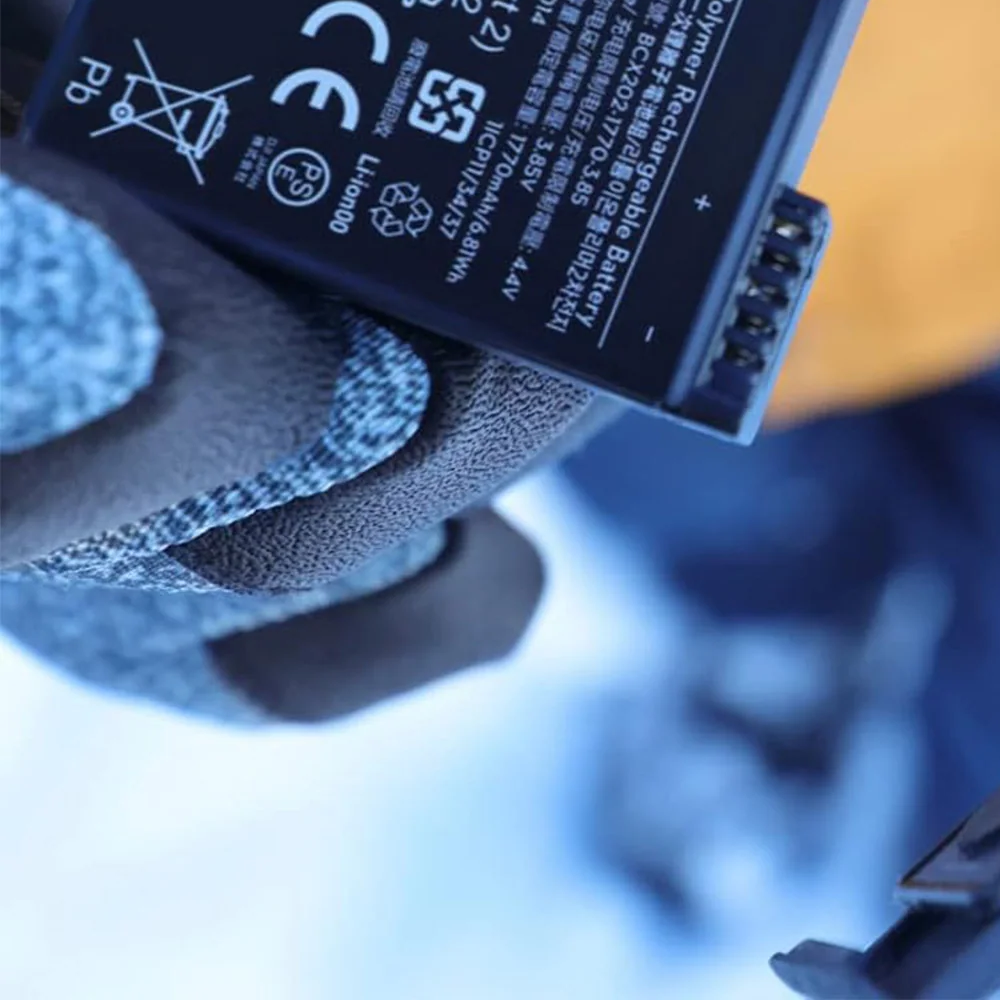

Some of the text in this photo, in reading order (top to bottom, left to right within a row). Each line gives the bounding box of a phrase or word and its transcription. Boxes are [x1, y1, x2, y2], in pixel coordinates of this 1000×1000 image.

[469, 17, 512, 53] 2)
[64, 56, 113, 105] Pb
[570, 31, 657, 207] BCX202-1770-3.85
[328, 153, 381, 234] Li-ion00
[439, 120, 504, 240] 1ICP11/34/37
[520, 137, 555, 193] 3.85V
[615, 84, 697, 240] Rechargeable
[446, 133, 528, 283] 1770mAh/6.81Wh
[501, 256, 529, 301] 4.4V
[575, 244, 631, 328] Battery
